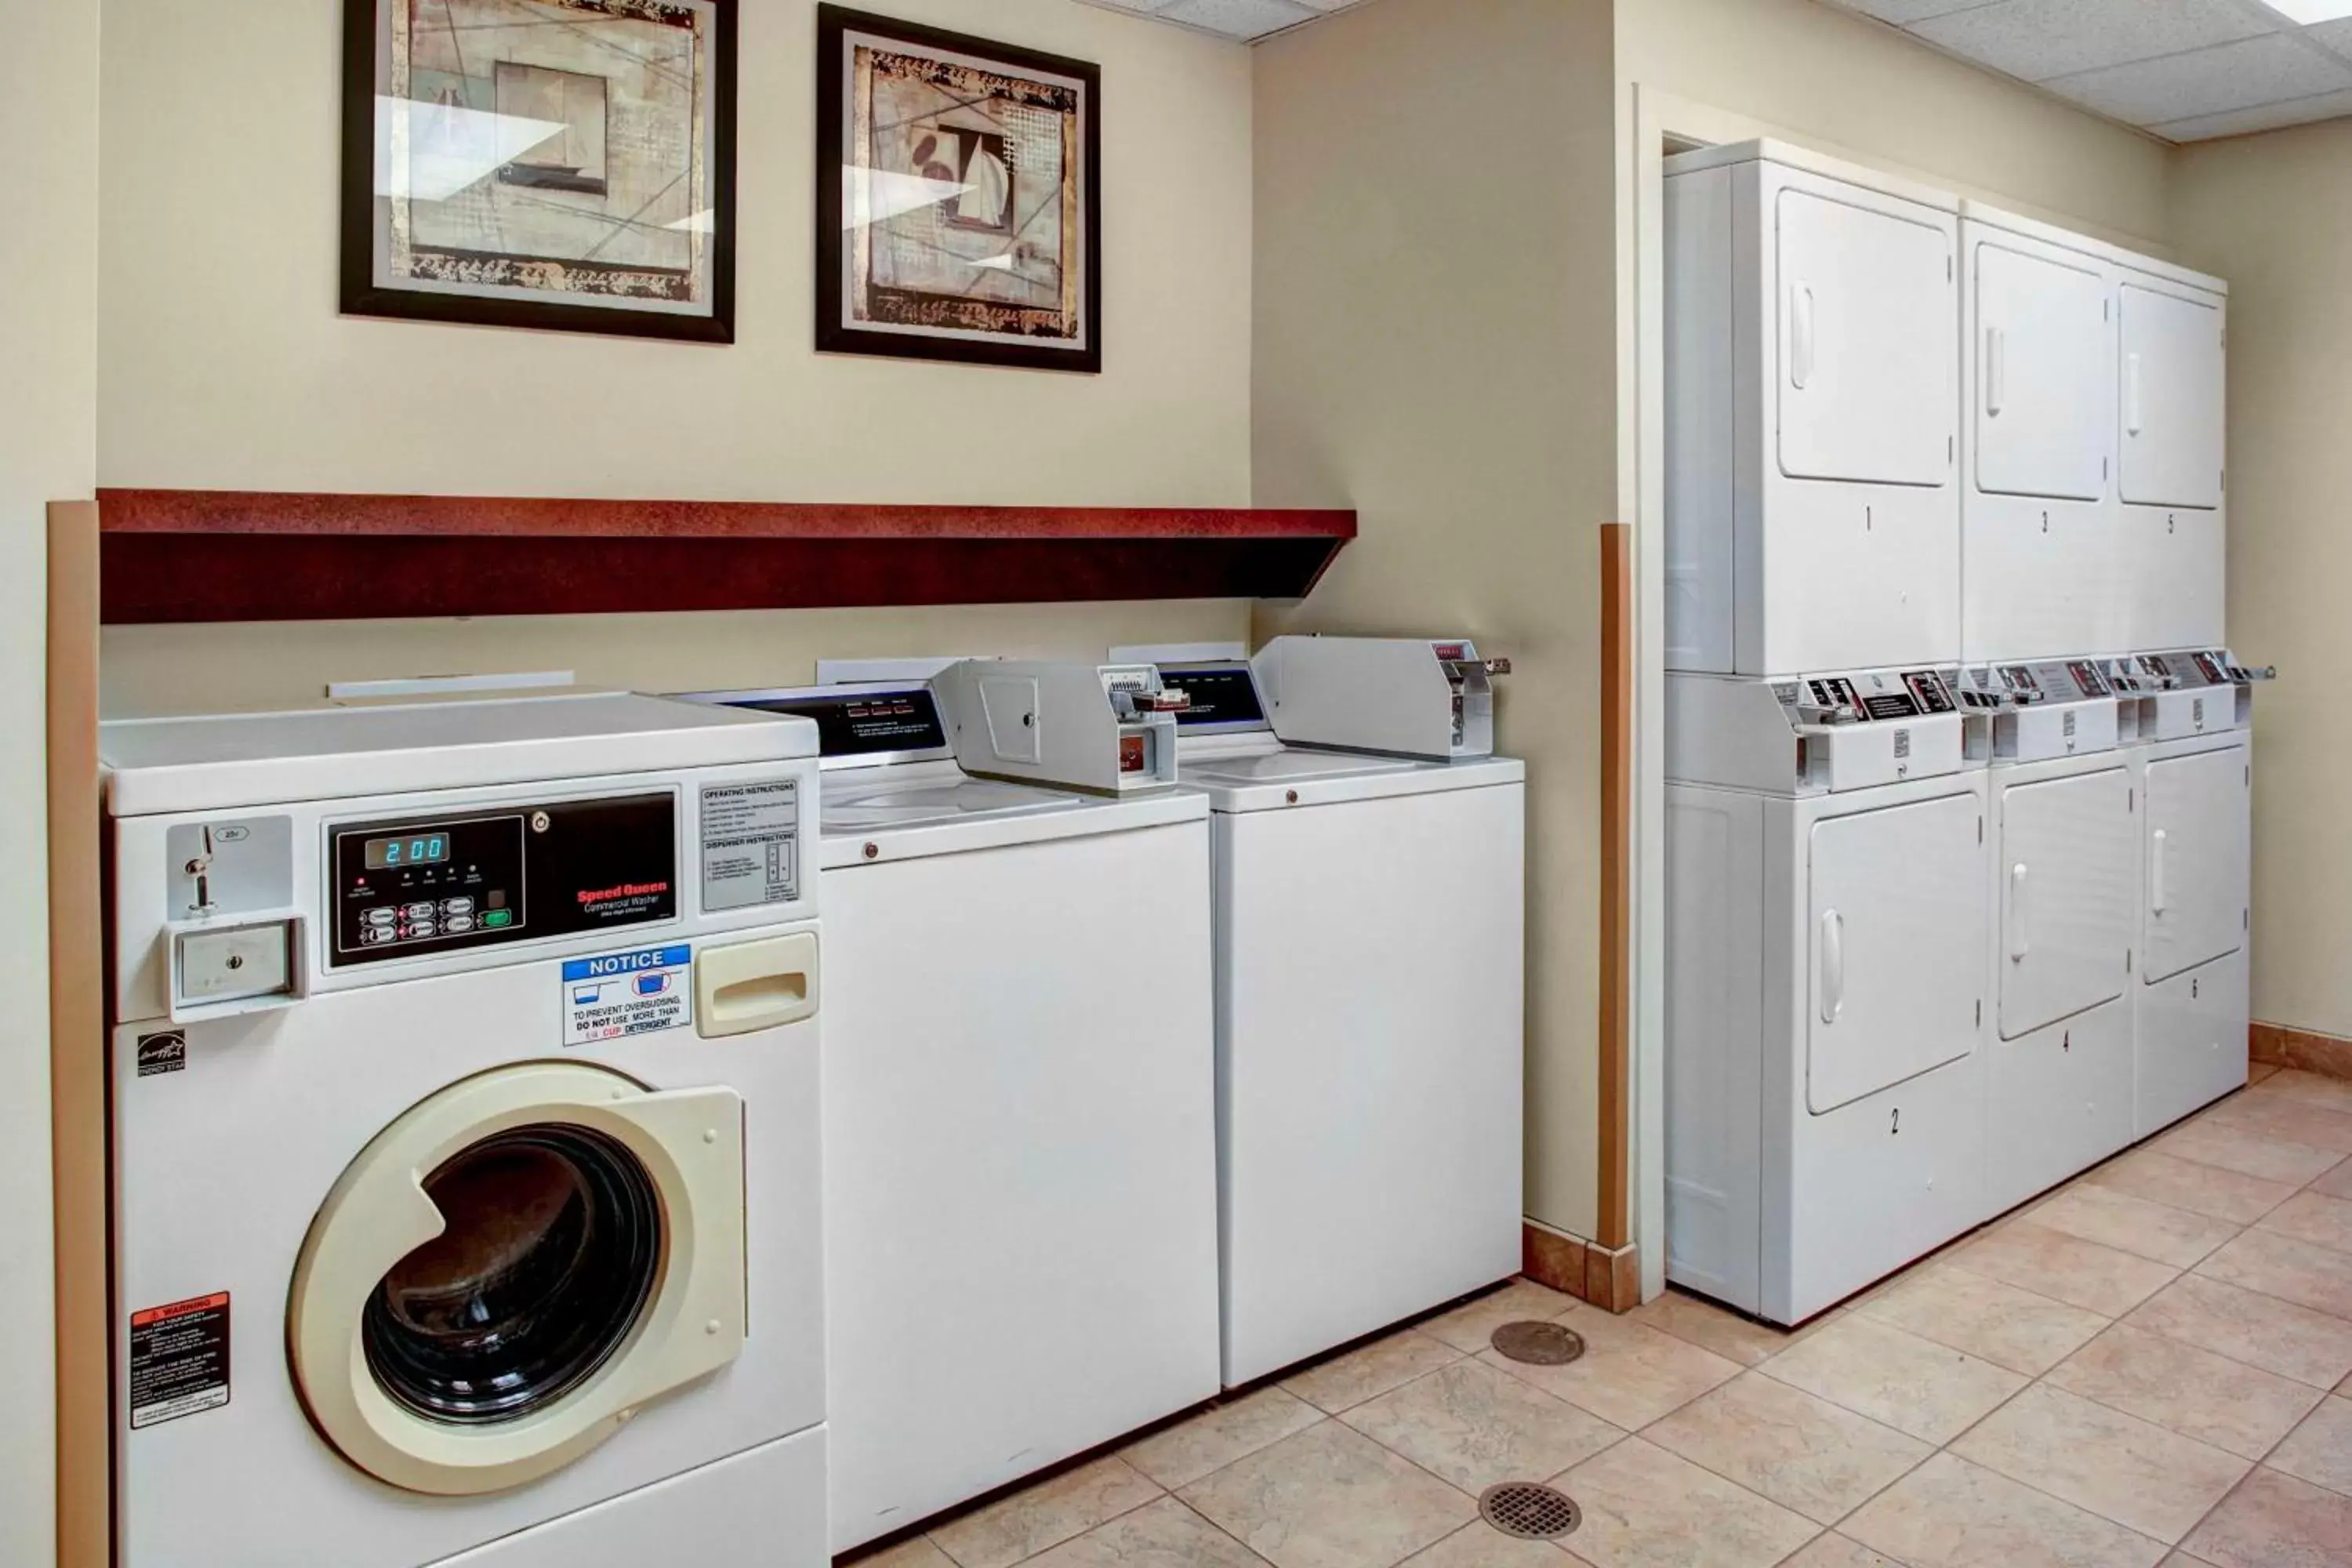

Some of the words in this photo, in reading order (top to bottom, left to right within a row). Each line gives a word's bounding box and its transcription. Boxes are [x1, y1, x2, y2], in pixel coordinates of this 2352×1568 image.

[1866, 505, 1871, 532] 1
[2042, 510, 2048, 533] 3
[704, 787, 744, 799] OPERATING
[745, 783, 794, 794] INSTRUCTIONS
[577, 885, 622, 903] Speed
[623, 881, 666, 897] Queen
[584, 898, 629, 913] Commercial
[631, 895, 659, 906] Washer
[590, 950, 664, 975] NOTICE
[574, 1011, 585, 1021] TO
[586, 1004, 626, 1018] PREVENT
[576, 1021, 590, 1031] DO
[592, 1017, 611, 1028] NOT
[612, 1014, 628, 1024] USE
[633, 1011, 655, 1020] MORE
[659, 1006, 680, 1017] THAN
[602, 1026, 622, 1037] CUP
[625, 1018, 672, 1033] DETERGENT
[2063, 1029, 2070, 1052] 4
[1891, 1108, 1899, 1134] 2
[162, 1298, 211, 1316] WARNING
